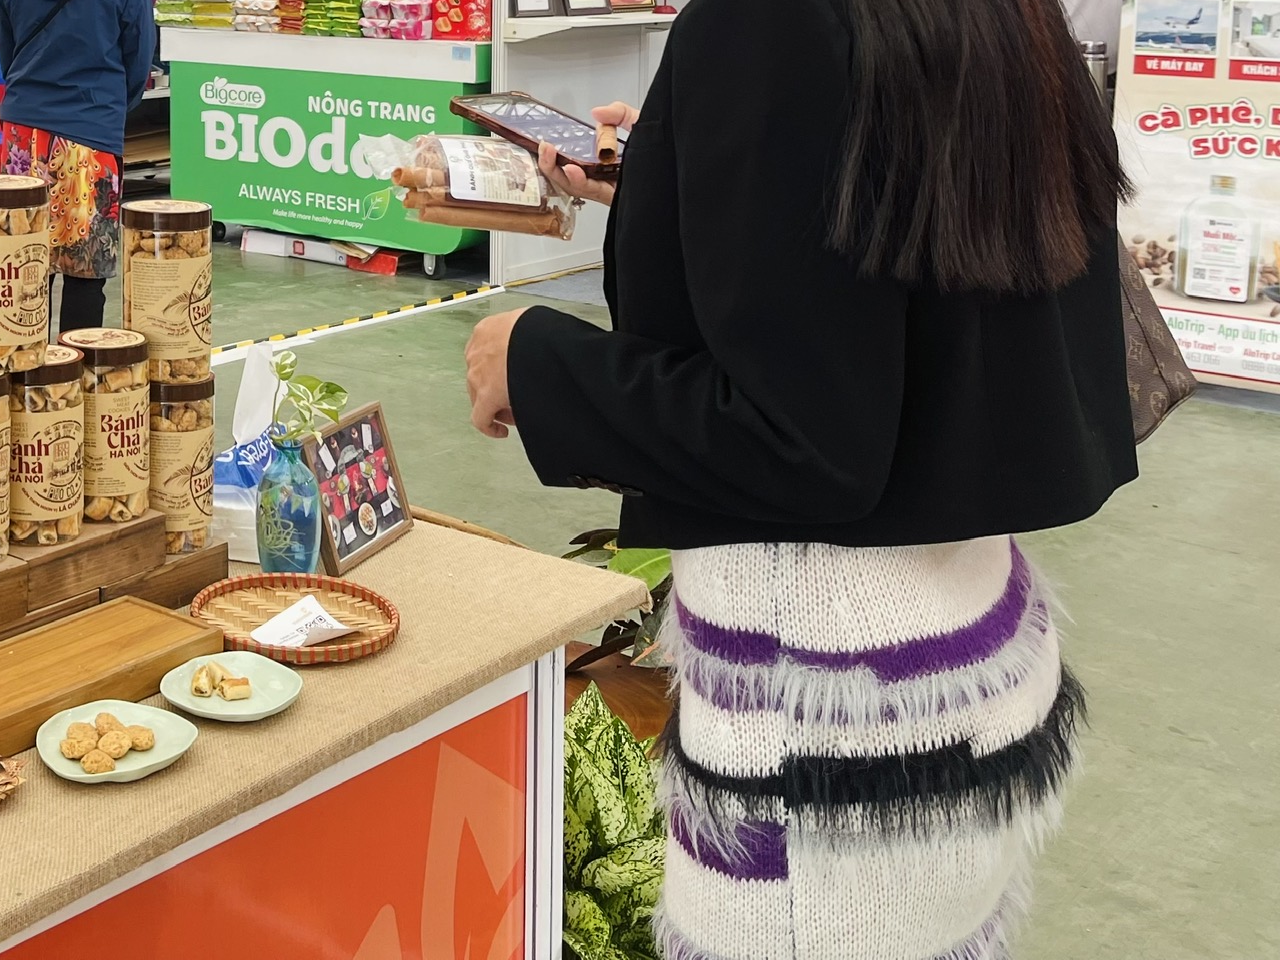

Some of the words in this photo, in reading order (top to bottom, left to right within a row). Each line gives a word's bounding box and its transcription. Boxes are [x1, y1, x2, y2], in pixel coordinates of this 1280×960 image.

[1185, 61, 1204, 72] BAY
[204, 83, 262, 105] Bigcore
[307, 90, 363, 118] NÔNG
[367, 100, 436, 125] TRANG
[238, 183, 302, 206] ALWAYS
[305, 192, 361, 214] FRESH
[272, 208, 287, 218] Make
[345, 219, 363, 230] happy
[1218, 324, 1240, 341] App
[100, 410, 144, 432] Bánh
[11, 438, 50, 457] ánh
[107, 429, 141, 449] Chả
